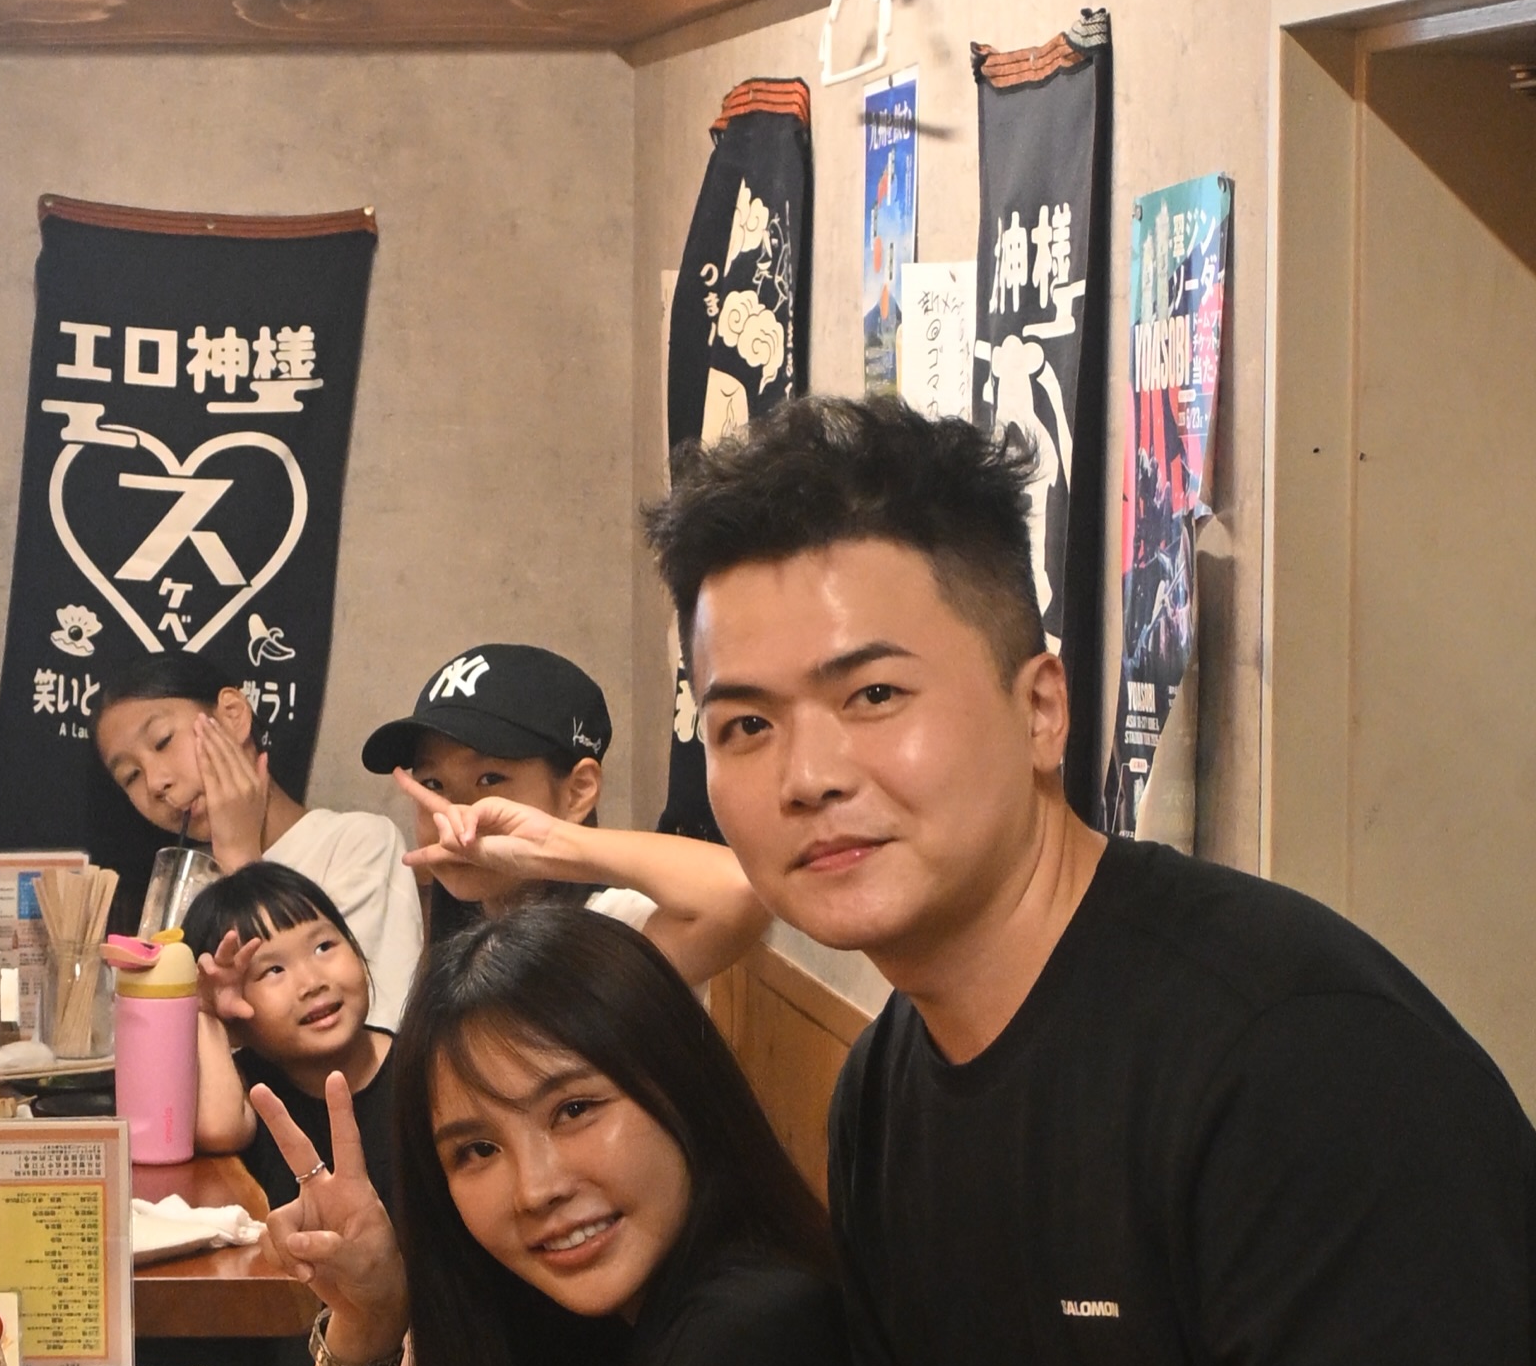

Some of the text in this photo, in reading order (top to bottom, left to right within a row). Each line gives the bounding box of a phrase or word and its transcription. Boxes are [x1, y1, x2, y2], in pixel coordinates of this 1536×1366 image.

[57, 321, 316, 394] エロ神様
[1135, 314, 1190, 393] YOASOBI
[429, 655, 490, 702] NY
